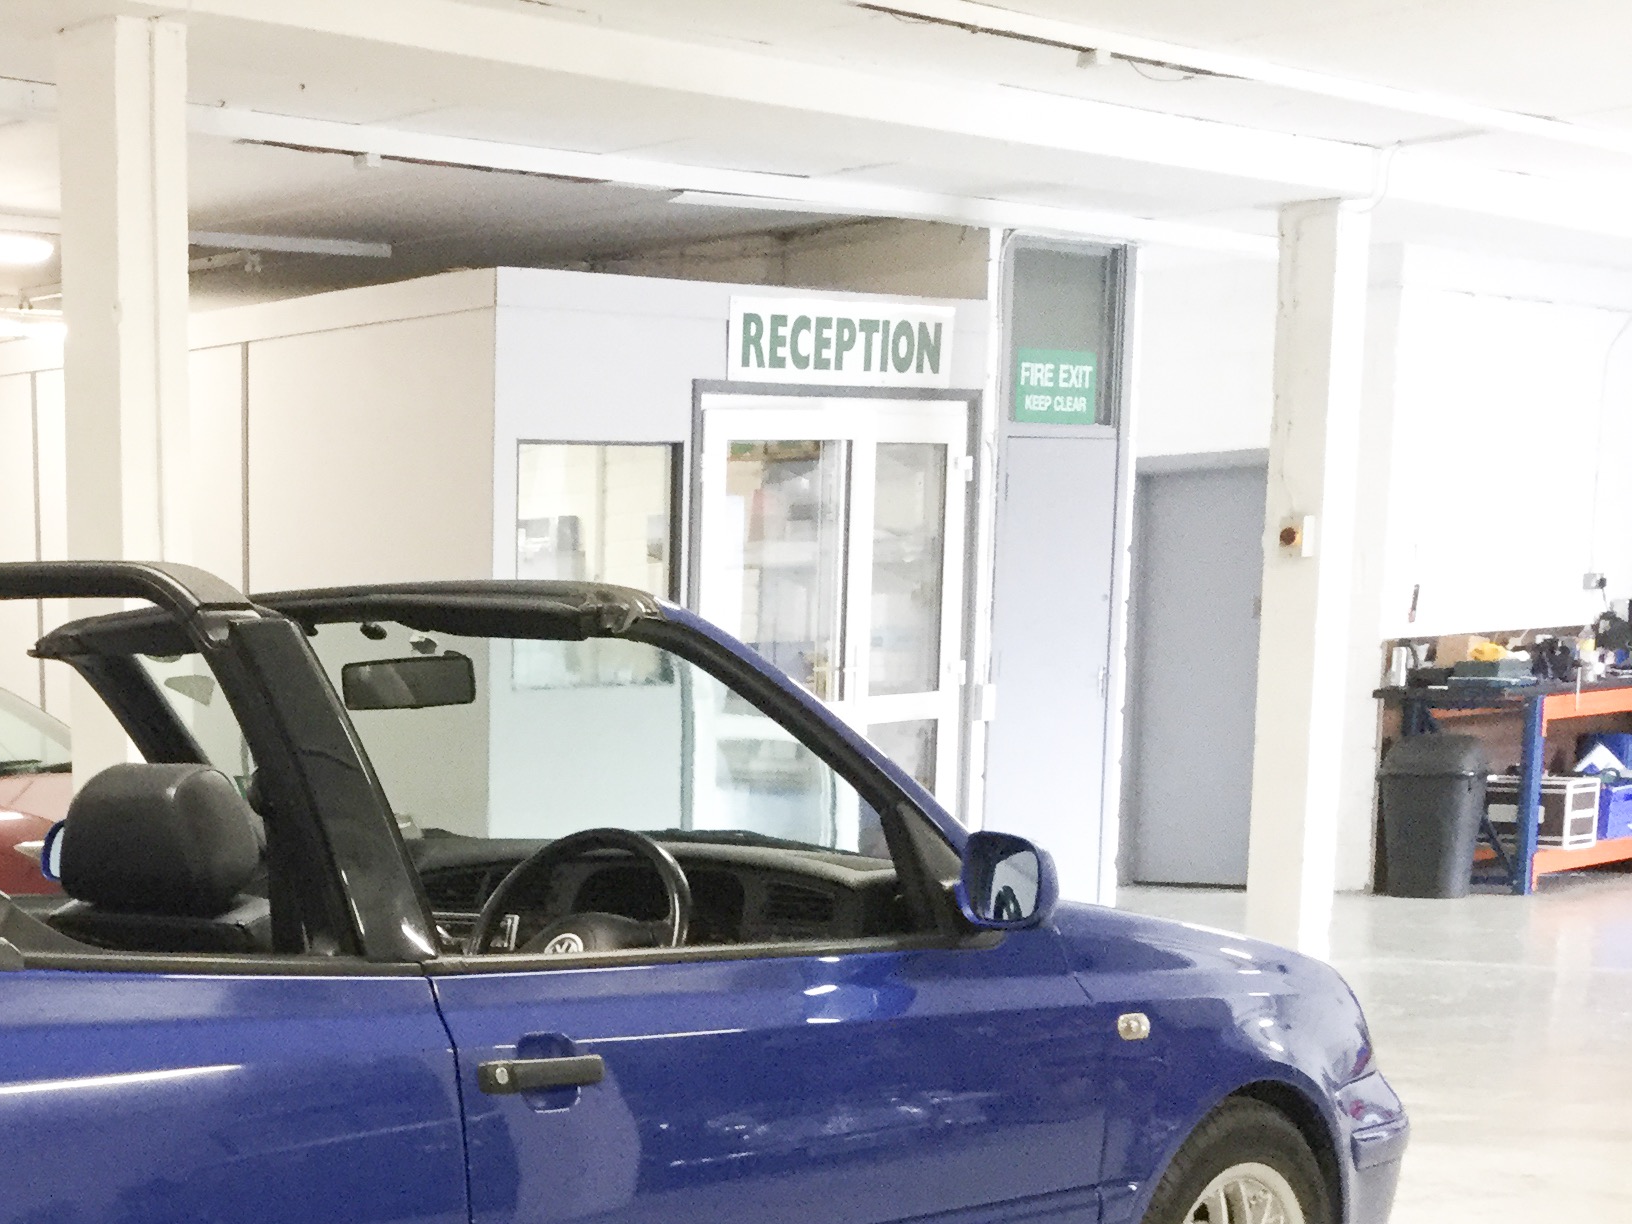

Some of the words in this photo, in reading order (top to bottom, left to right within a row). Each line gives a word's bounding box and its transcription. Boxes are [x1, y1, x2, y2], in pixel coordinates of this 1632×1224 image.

[741, 312, 943, 374] RECEPTION
[1020, 362, 1055, 387] FIRE
[1058, 364, 1093, 389] EXIT
[1024, 394, 1051, 411] KEEP
[1053, 395, 1087, 412] CLEAR
